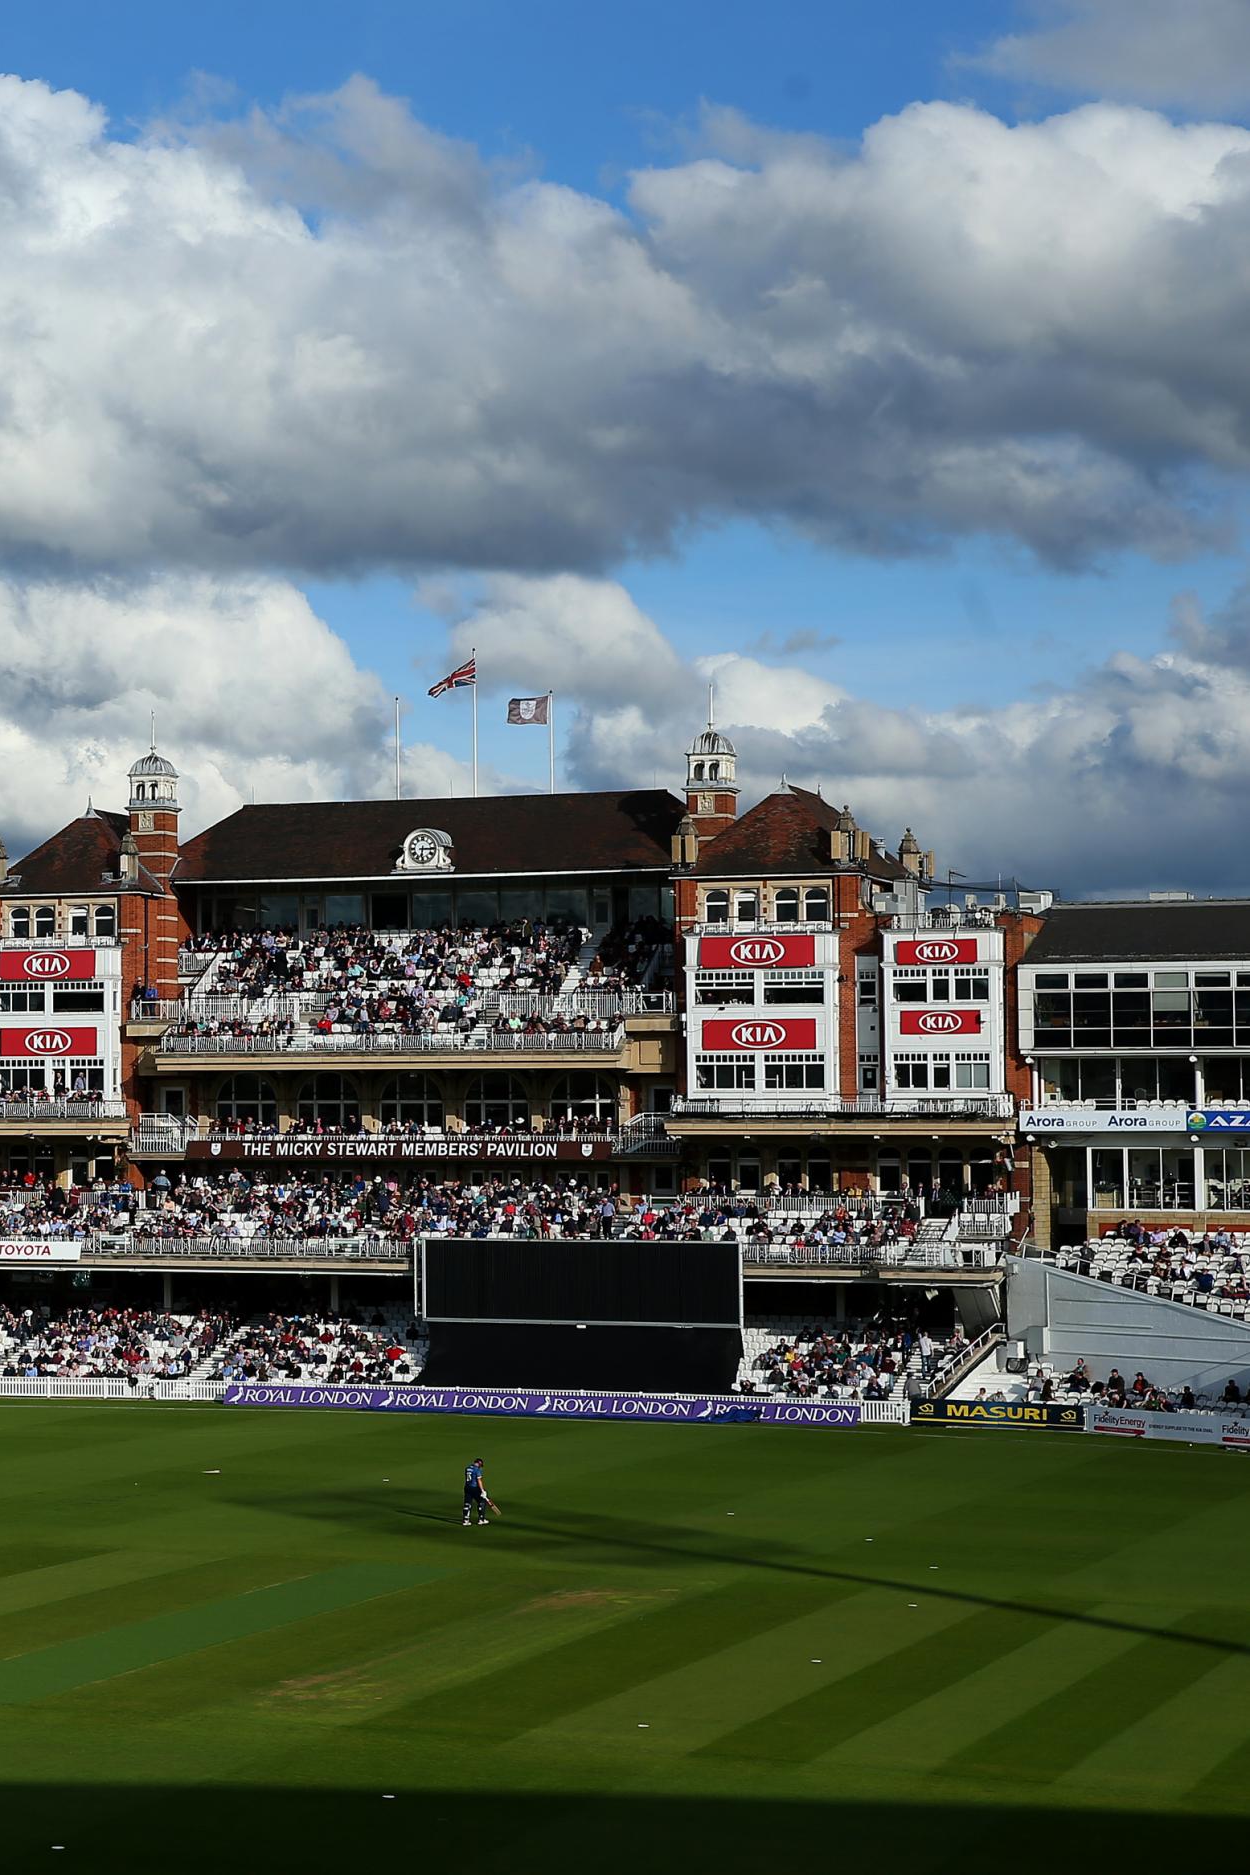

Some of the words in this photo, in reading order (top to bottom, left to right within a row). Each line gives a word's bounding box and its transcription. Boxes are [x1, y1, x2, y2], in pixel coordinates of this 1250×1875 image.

[740, 943, 776, 959] KIA
[923, 945, 952, 958] KIA
[31, 958, 62, 972] KIA
[926, 1015, 955, 1028] KIA
[33, 1034, 63, 1049] KIA
[741, 1027, 778, 1042] KIA
[1026, 1115, 1065, 1127] Arora
[1108, 1115, 1147, 1127] Arora
[1209, 1115, 1250, 1127] AZ
[242, 1143, 271, 1156] THE
[276, 1143, 323, 1156] MICKY
[327, 1143, 397, 1156] STEWART
[486, 1143, 557, 1157] PAVILION
[245, 1389, 295, 1403] ROYAL
[299, 1390, 373, 1405] LONDON
[395, 1393, 448, 1408] ROYAL
[452, 1394, 529, 1410] LONDON
[552, 1398, 607, 1413] ROYAL
[611, 1399, 691, 1416] LONDON
[774, 1406, 856, 1423] LONDON
[946, 1404, 1047, 1420] MASURI
